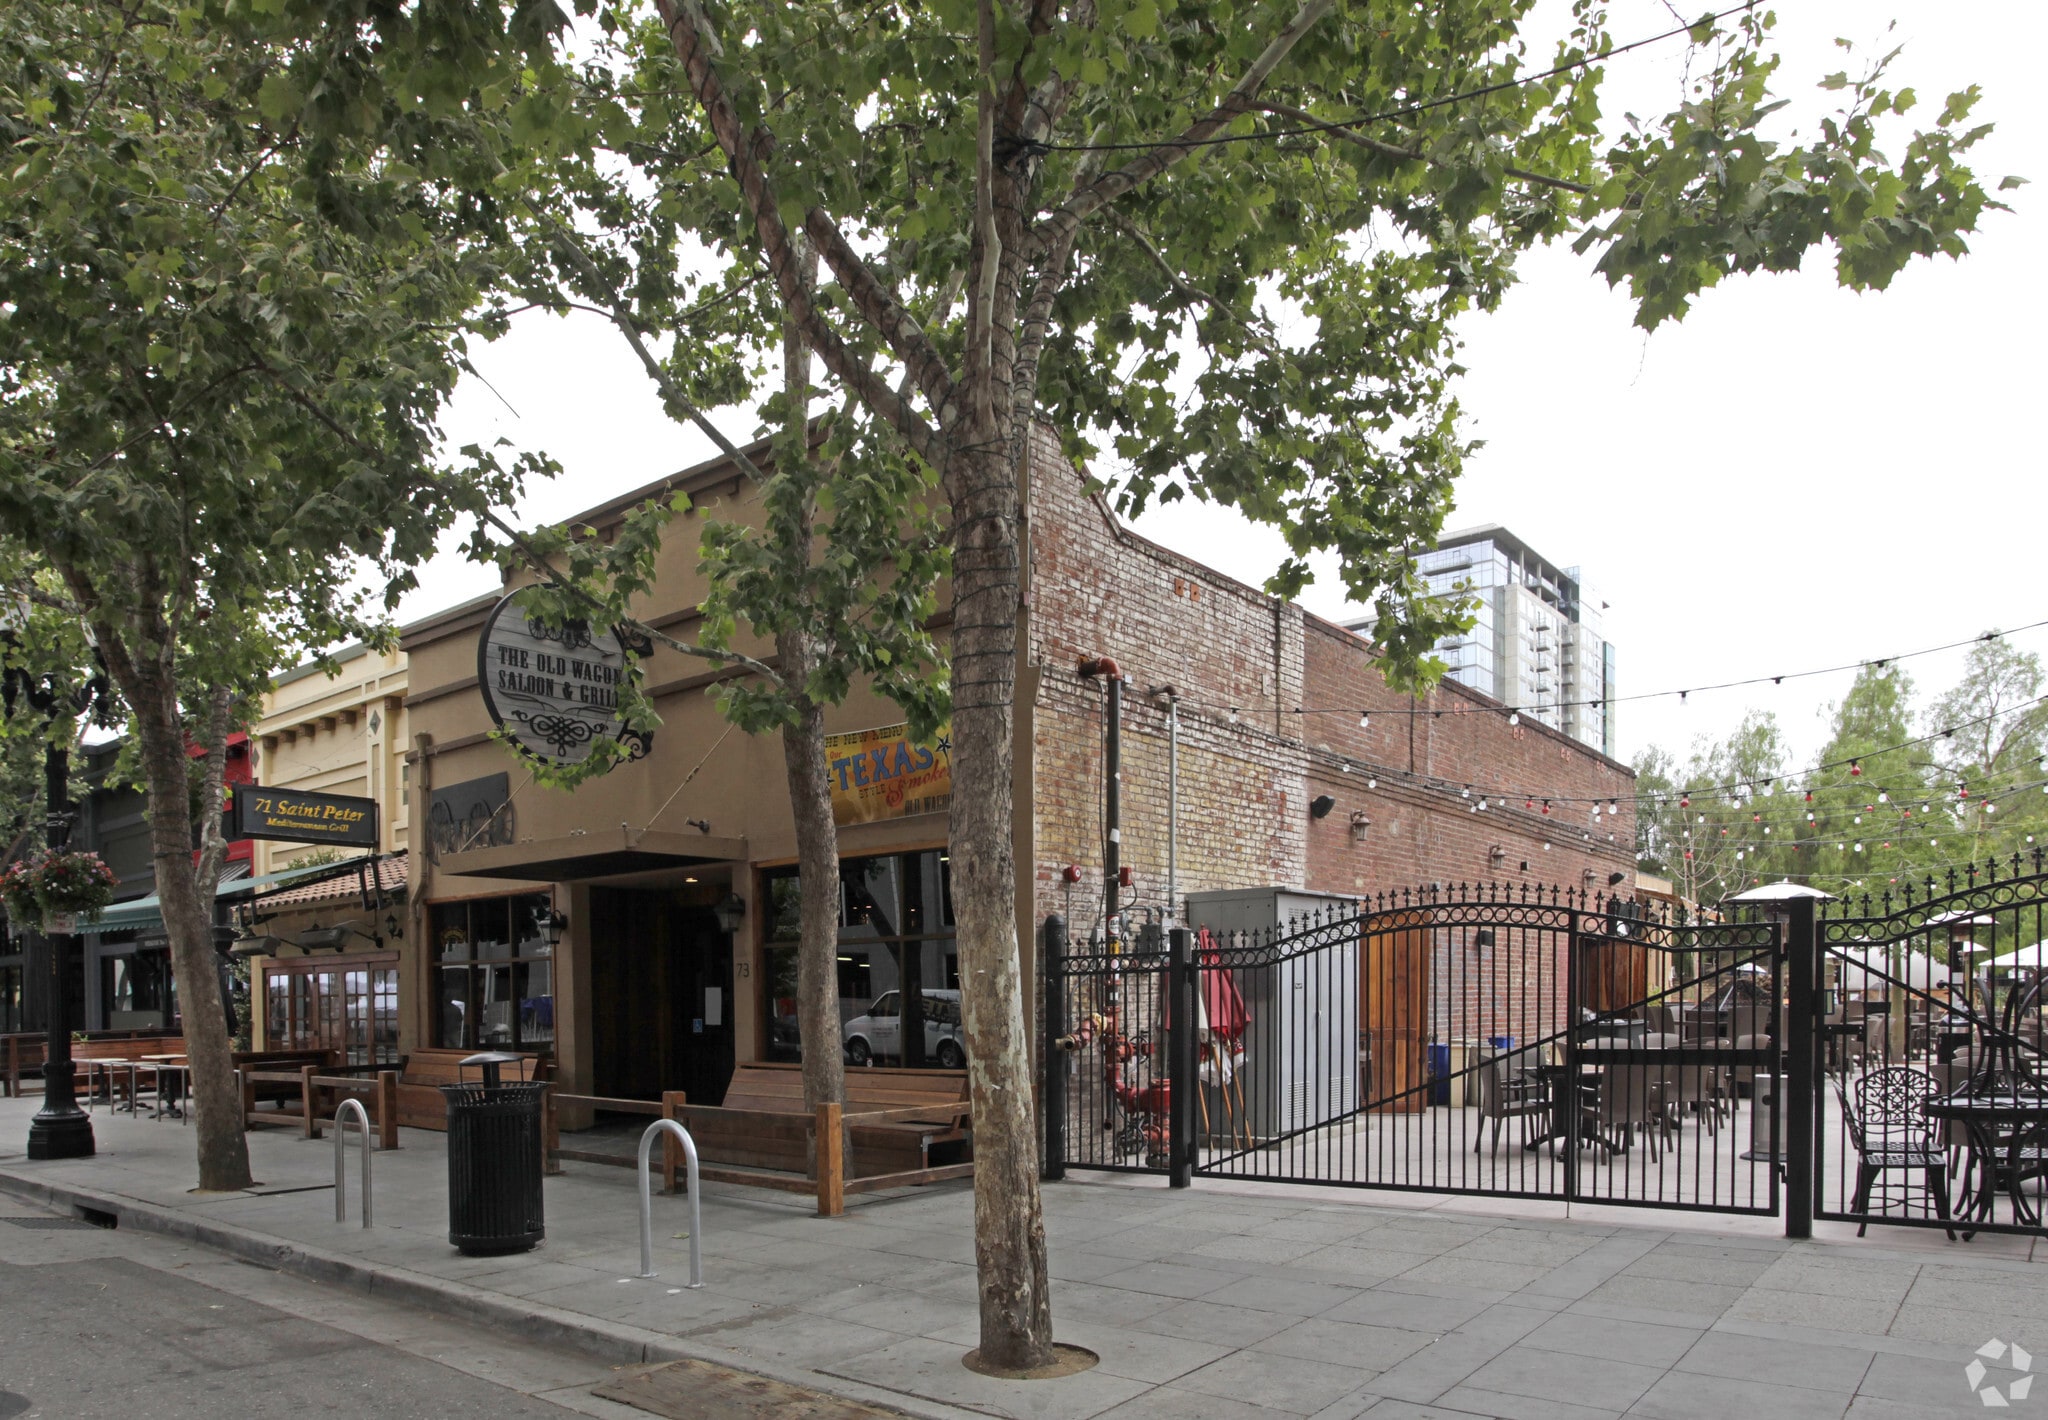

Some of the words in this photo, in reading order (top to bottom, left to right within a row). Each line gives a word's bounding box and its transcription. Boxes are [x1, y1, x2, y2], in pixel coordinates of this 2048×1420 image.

[498, 646, 530, 670] THE
[536, 656, 566, 676] OLD
[571, 660, 622, 686] WAGON
[498, 670, 554, 697] SALOON
[562, 681, 574, 700] &
[825, 736, 838, 748] HE
[843, 731, 869, 745] NEW
[872, 725, 903, 741] MENU
[830, 751, 842, 759] Our
[832, 741, 935, 792] TEXAS
[859, 784, 886, 798] STYLE
[255, 798, 272, 814] 71
[277, 800, 321, 817] Saint
[323, 805, 365, 821] Peter
[904, 799, 920, 816] OLD
[266, 817, 328, 831] Mediterranean
[328, 823, 350, 833] Grill
[737, 963, 750, 977] 73
